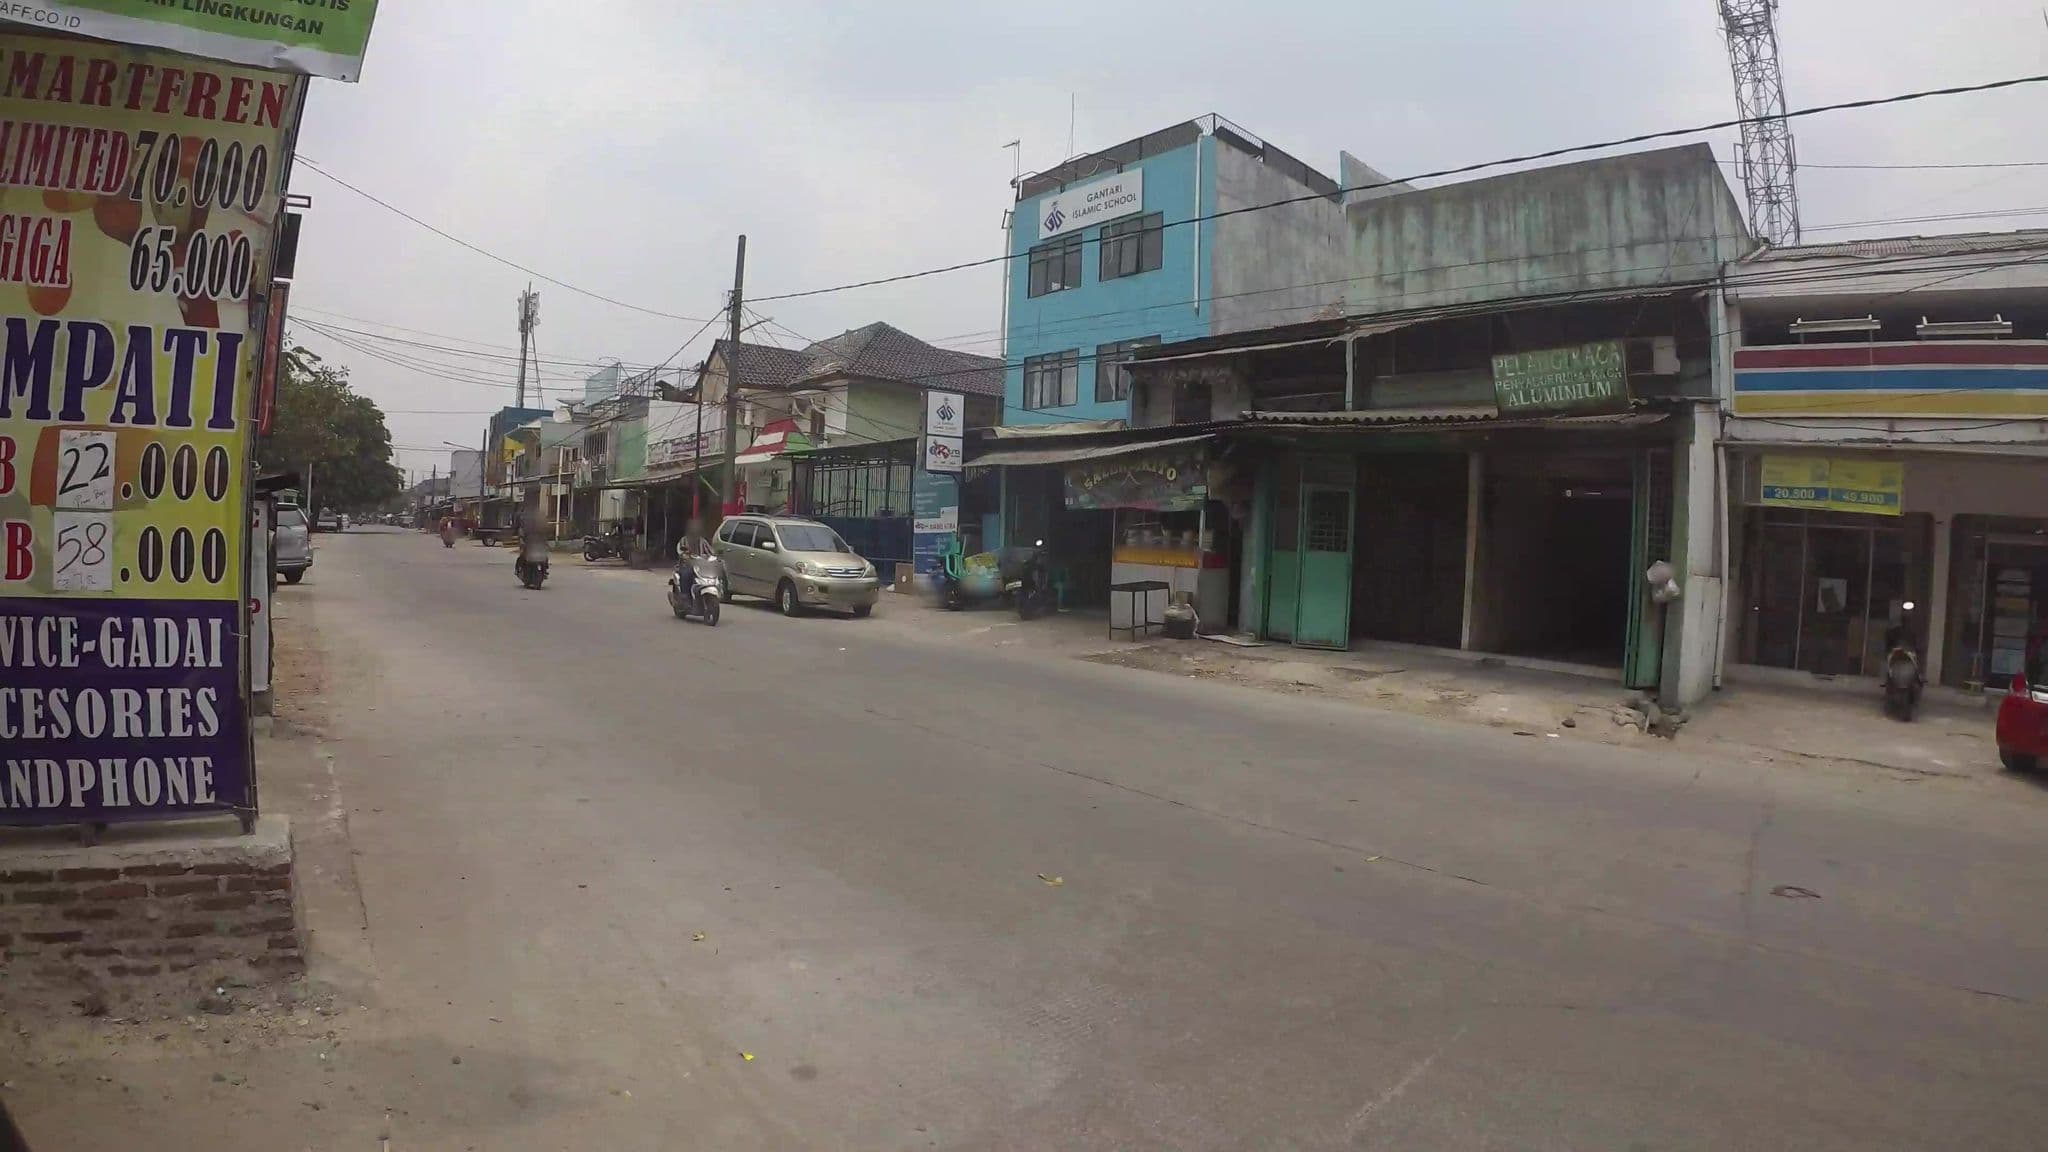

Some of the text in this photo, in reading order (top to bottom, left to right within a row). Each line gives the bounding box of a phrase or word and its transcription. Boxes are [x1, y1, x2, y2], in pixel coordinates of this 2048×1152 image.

[183, 0, 323, 35] LINGKUNGAN
[0, 50, 288, 128] MARTFREN
[130, 131, 268, 213] 70.000
[1086, 184, 1122, 202] GANTARI
[1072, 193, 1137, 219] ISLAMIC SCHOOL
[130, 227, 251, 299] 65.000
[1508, 381, 1611, 407] ALUMINIUM
[5, 522, 33, 580] B
